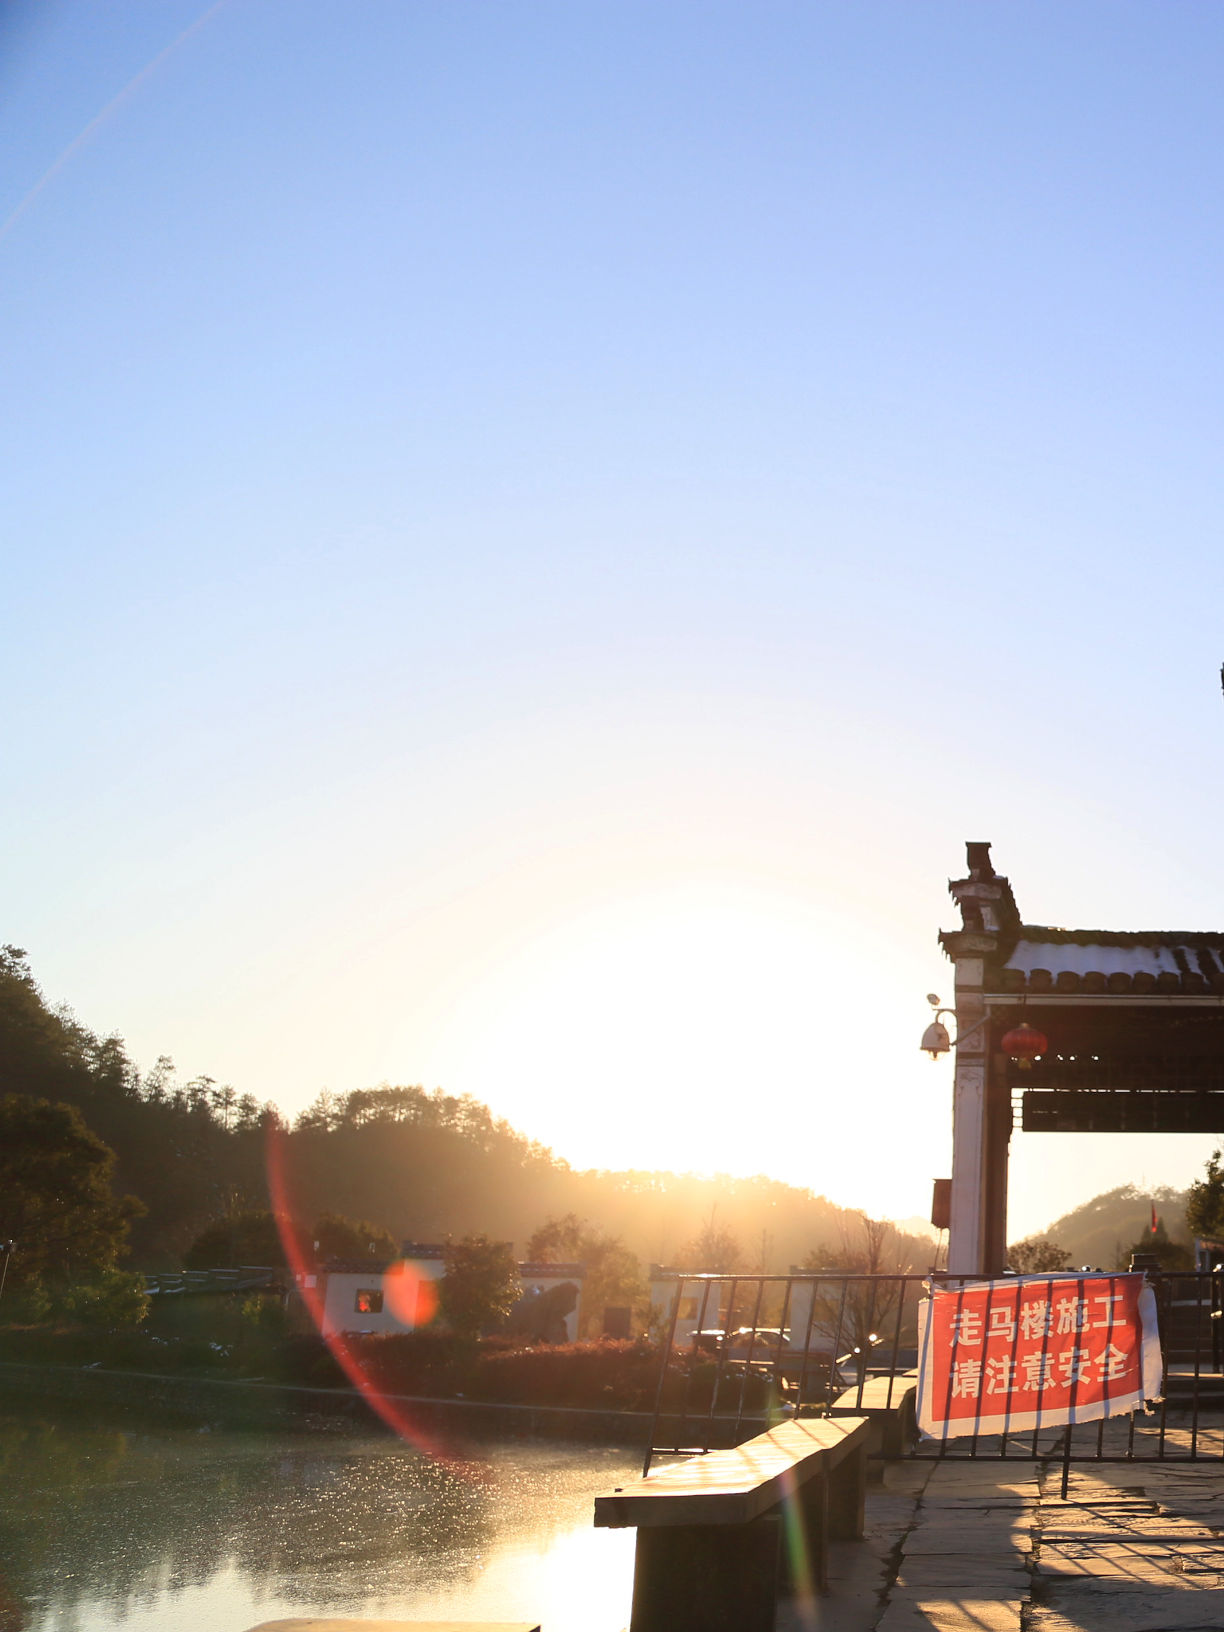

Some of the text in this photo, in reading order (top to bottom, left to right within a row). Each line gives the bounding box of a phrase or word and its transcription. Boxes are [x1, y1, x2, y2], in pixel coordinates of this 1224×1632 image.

[949, 1295, 1127, 1347] 走马楼施工
[949, 1343, 1129, 1398] 请注意安全
